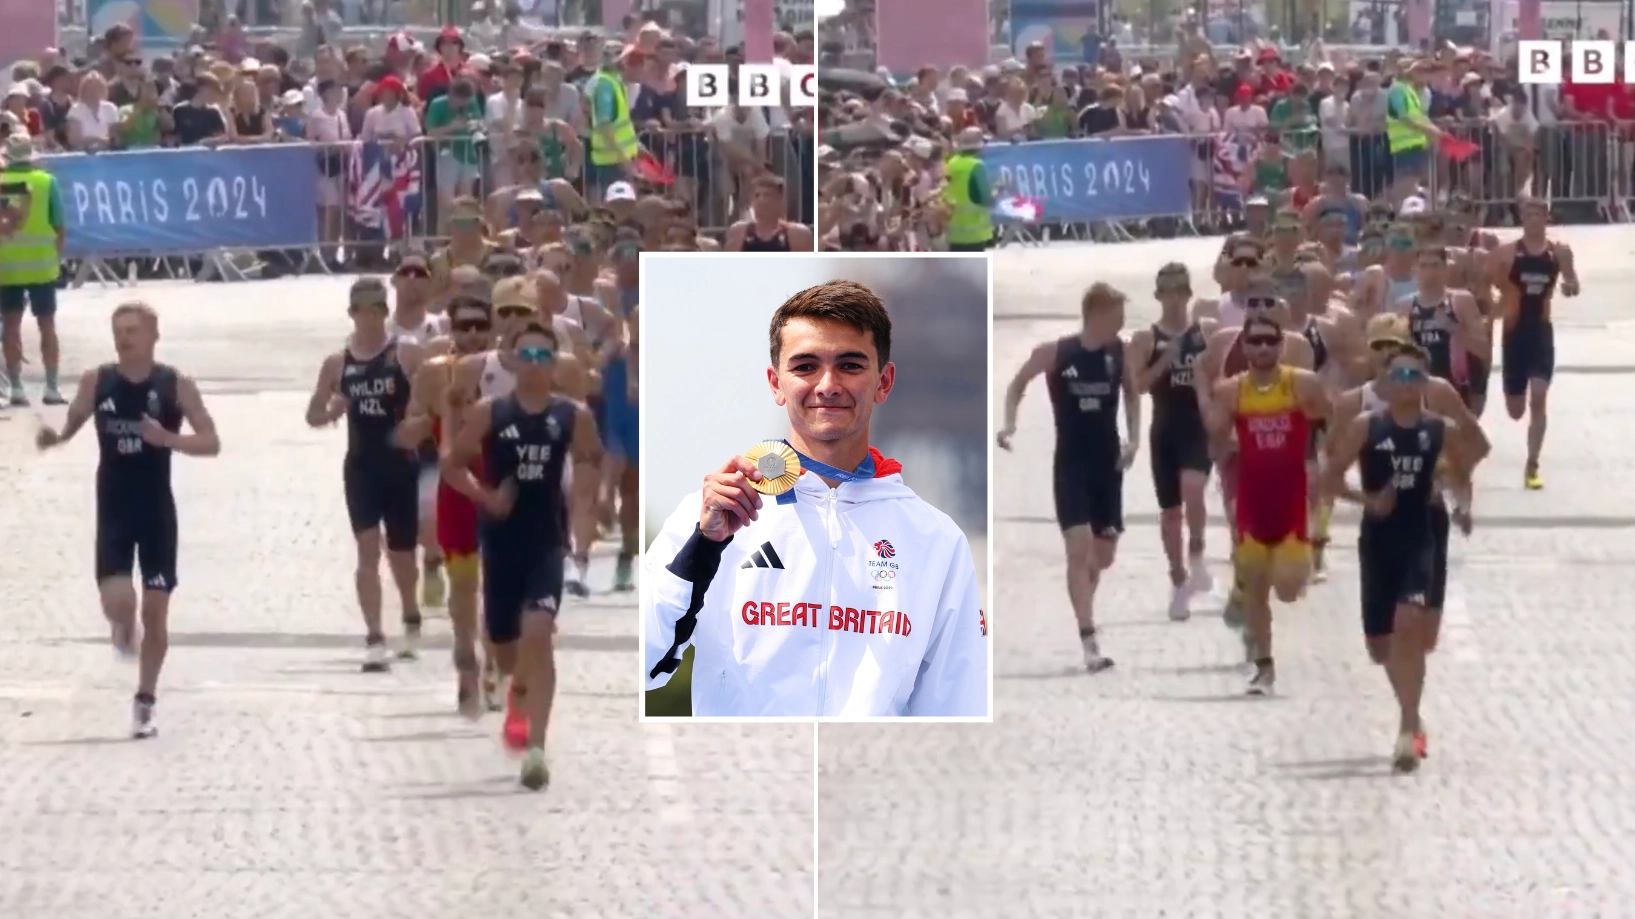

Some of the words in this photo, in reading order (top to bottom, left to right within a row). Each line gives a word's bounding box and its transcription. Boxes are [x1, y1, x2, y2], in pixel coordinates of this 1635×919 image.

[1085, 159, 1151, 196] 2024
[183, 175, 266, 221] 2024
[359, 398, 388, 416] NZL
[516, 443, 552, 462] YEE
[741, 600, 822, 628] GREAT
